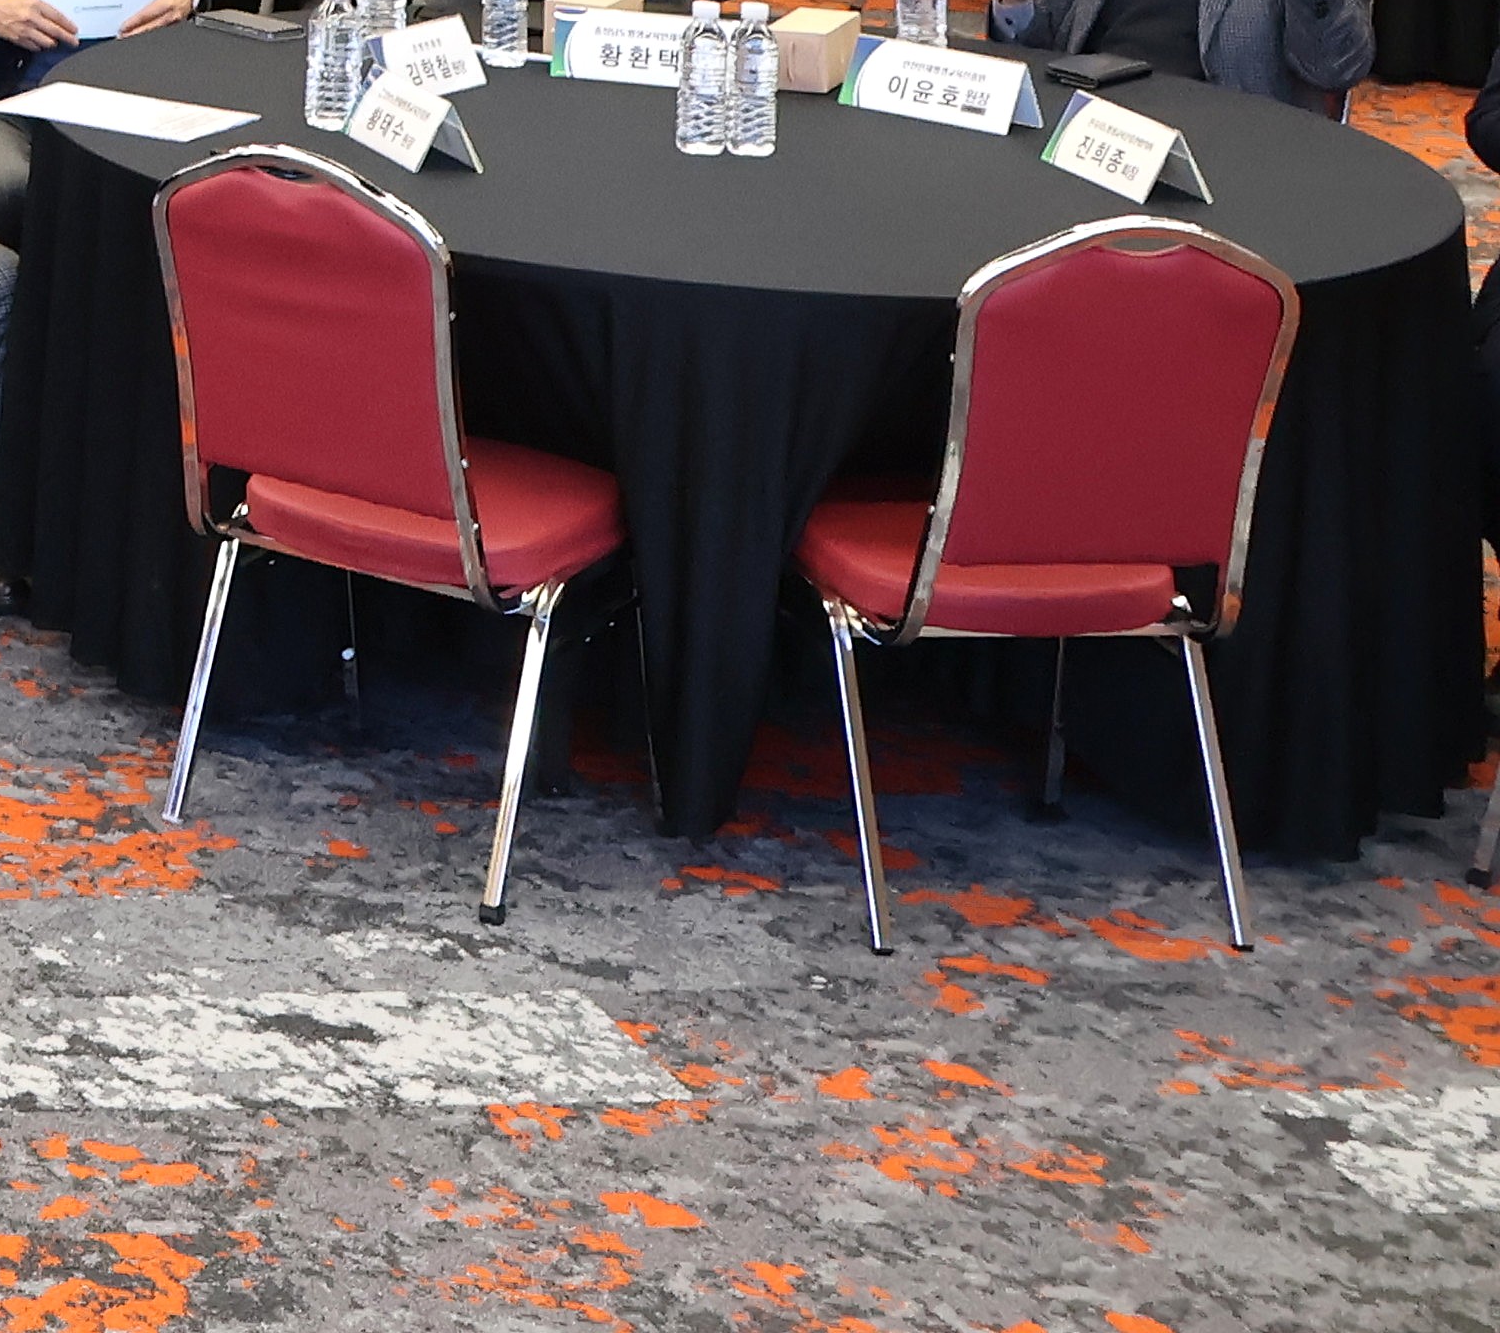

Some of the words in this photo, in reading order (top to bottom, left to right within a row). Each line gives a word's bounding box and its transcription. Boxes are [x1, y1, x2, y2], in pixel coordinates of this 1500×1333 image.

[599, 43, 680, 74] 황환택
[887, 75, 960, 108] 이윤호
[965, 89, 991, 107] 원장
[1075, 135, 1127, 174] 진희종
